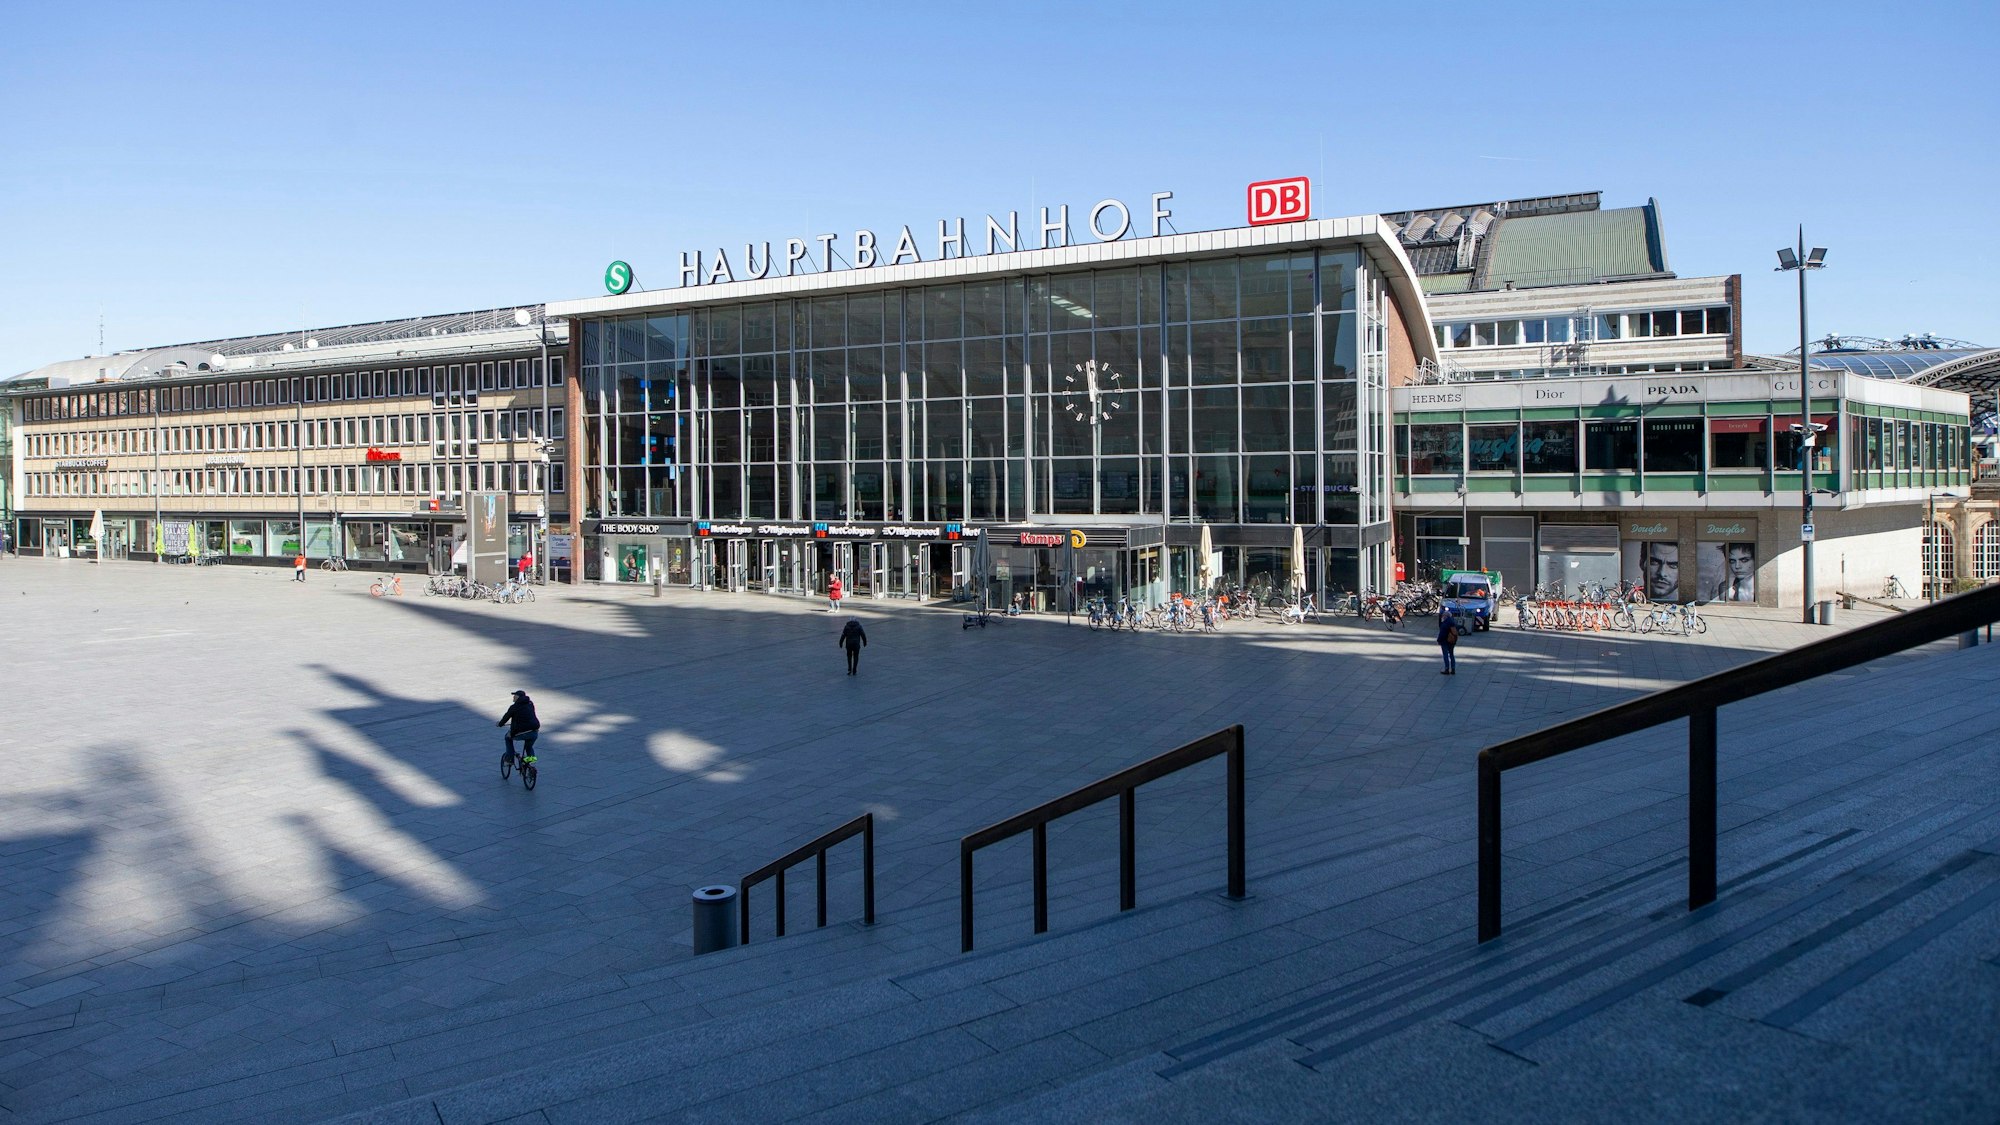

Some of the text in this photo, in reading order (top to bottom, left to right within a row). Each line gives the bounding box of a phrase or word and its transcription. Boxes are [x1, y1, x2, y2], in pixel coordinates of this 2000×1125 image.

[1255, 186, 1302, 219] DB
[679, 191, 1174, 288] HAUPTBAHNHOF
[608, 265, 625, 290] S
[1535, 389, 1565, 400] Dior
[1647, 385, 1699, 395] PRADA
[86, 459, 107, 467] COFFEE
[601, 524, 660, 534] THE BODY SHOP
[710, 525, 753, 535] NetCologne
[828, 526, 940, 538] NetCologne Highspeed
[1630, 523, 1669, 536] Douglas
[1706, 523, 1746, 536] Douglas
[1020, 532, 1063, 547] Kamps
